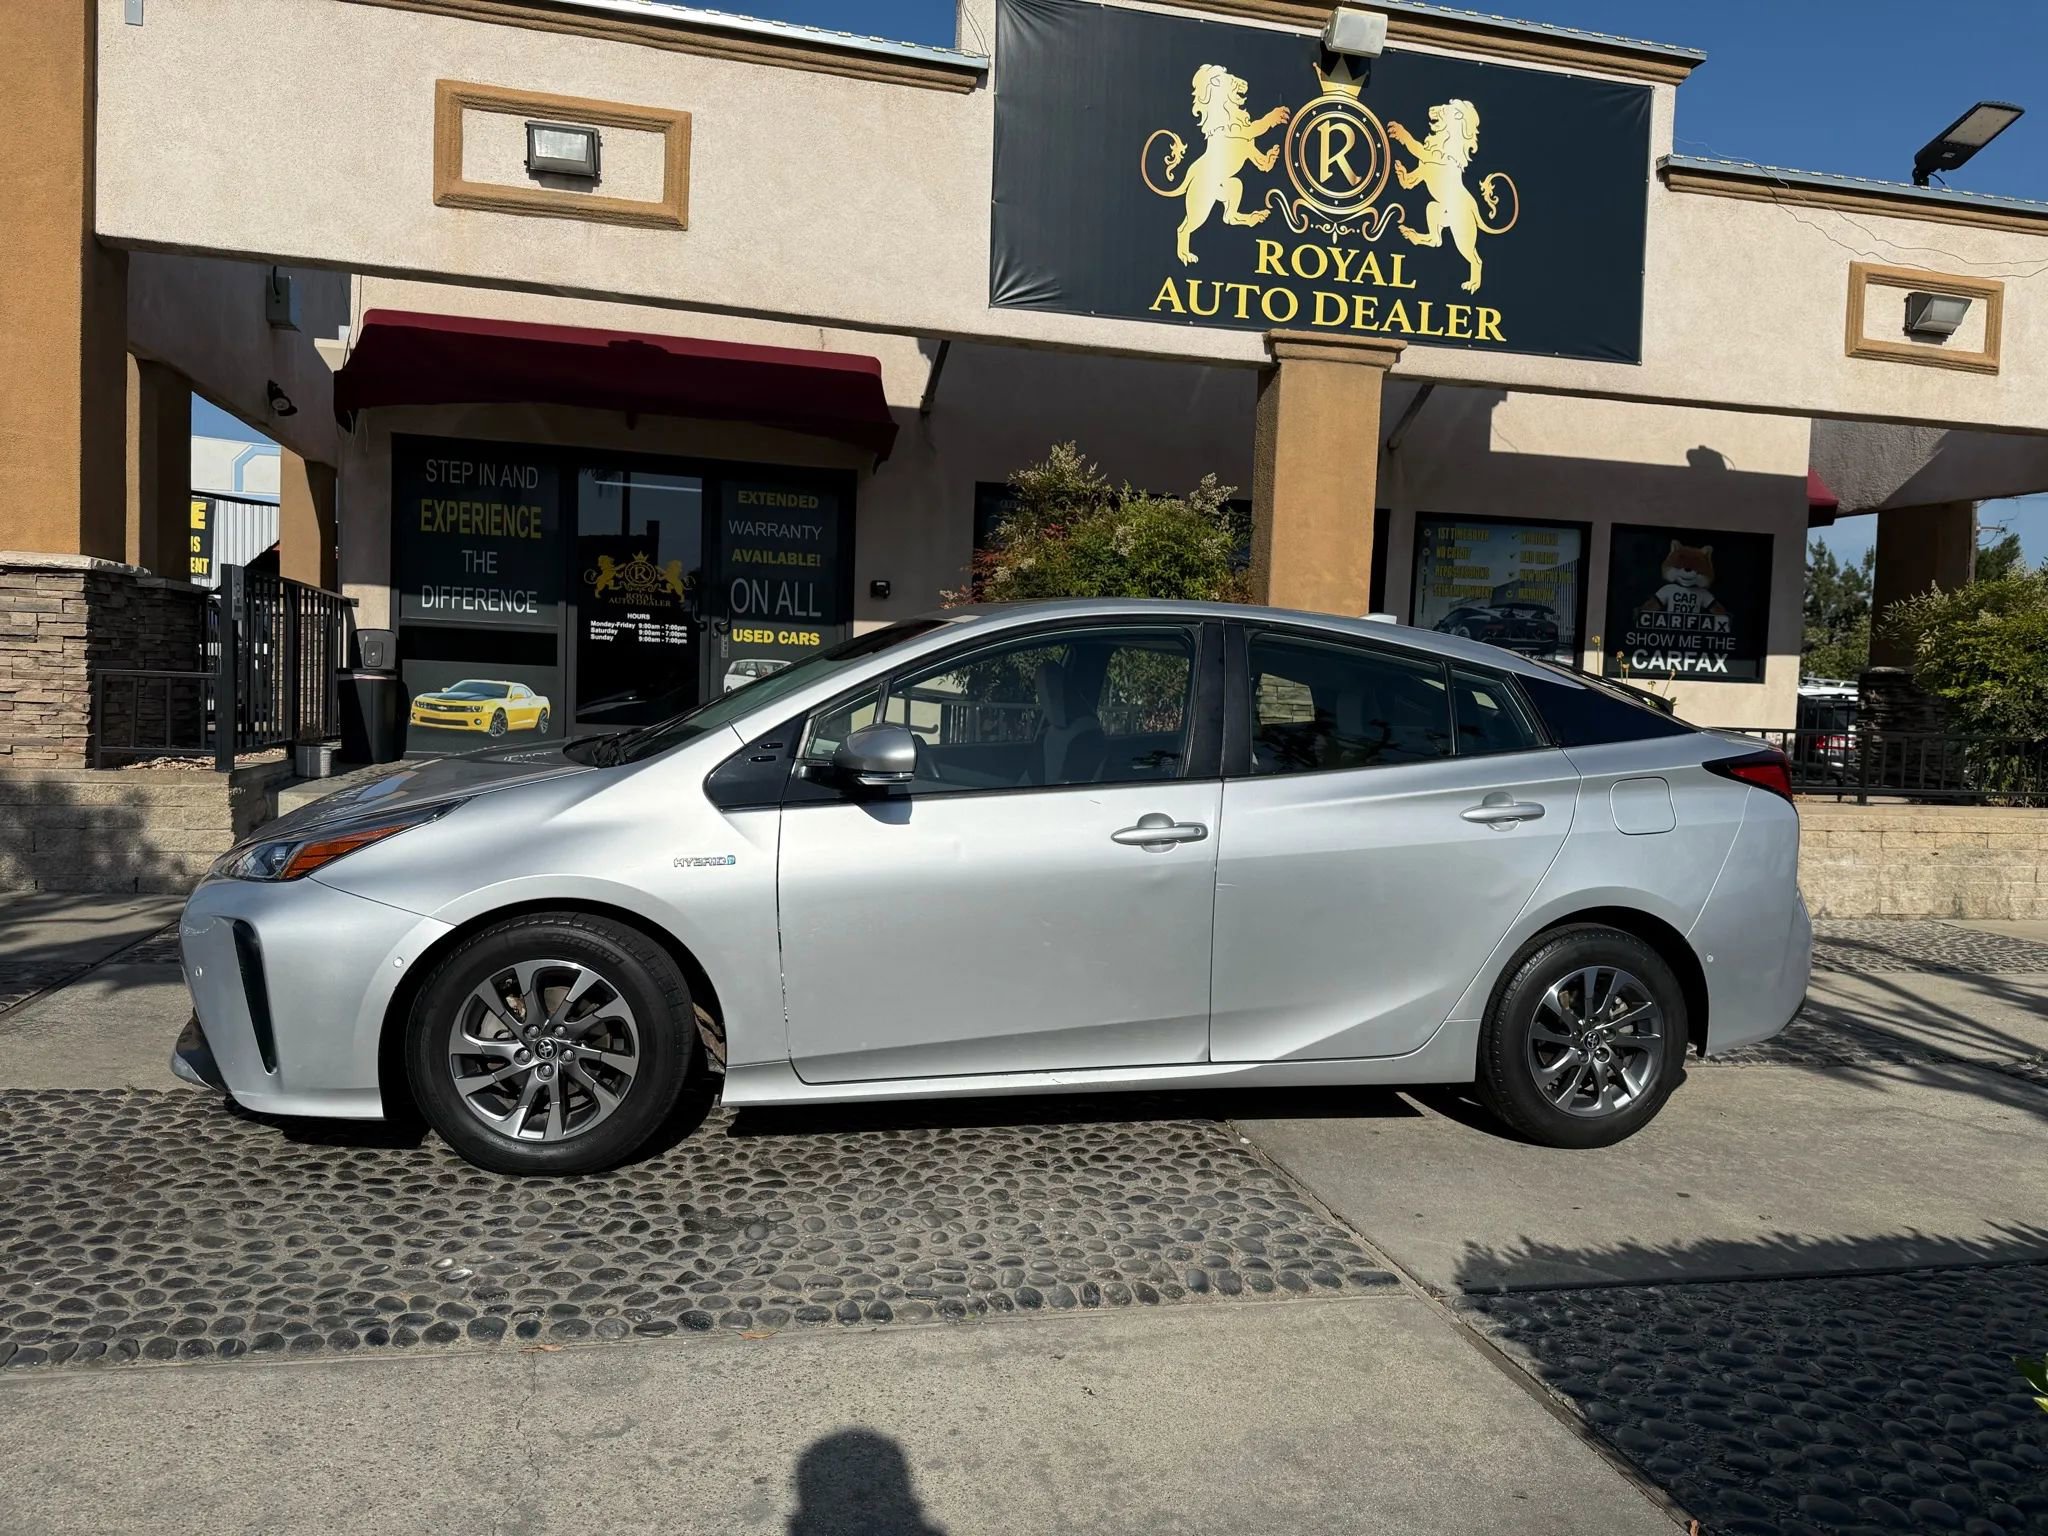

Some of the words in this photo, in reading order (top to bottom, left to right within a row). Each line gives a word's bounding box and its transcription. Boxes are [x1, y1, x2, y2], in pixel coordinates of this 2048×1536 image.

[1318, 120, 1362, 187] R
[1254, 239, 1417, 289] ROYAL
[1148, 276, 1300, 322] AUTO
[1311, 290, 1507, 342] DEALER
[425, 459, 474, 485] STEP
[478, 463, 496, 485] IN
[499, 464, 539, 489] AND
[737, 490, 819, 509] EXTENDED
[420, 499, 542, 539] EXPERIENCE
[728, 520, 822, 541] WARRANTY
[462, 549, 498, 575] THE
[731, 548, 821, 567] AVAILABLE!
[421, 585, 538, 614] DIFFERENCE
[730, 577, 770, 614] ON
[774, 581, 822, 617] ALL
[1673, 592, 1697, 604] CAR
[1674, 604, 1696, 613] FOX
[590, 620, 636, 630] Monday-Friday
[665, 624, 688, 632] 7:00pm
[1640, 613, 1730, 632] CARFAX
[590, 627, 618, 635] Saturday
[665, 630, 688, 638] 7:00pm
[590, 634, 614, 642] Sunday
[665, 637, 688, 645] 7:00pm
[732, 628, 775, 645] USED
[778, 629, 821, 647] CARS
[1625, 632, 1675, 647] SHOW
[1678, 635, 1701, 649] ME
[1704, 636, 1737, 650] THE
[1632, 648, 1729, 673] CARFAX
[673, 856, 726, 867] HYBRID
